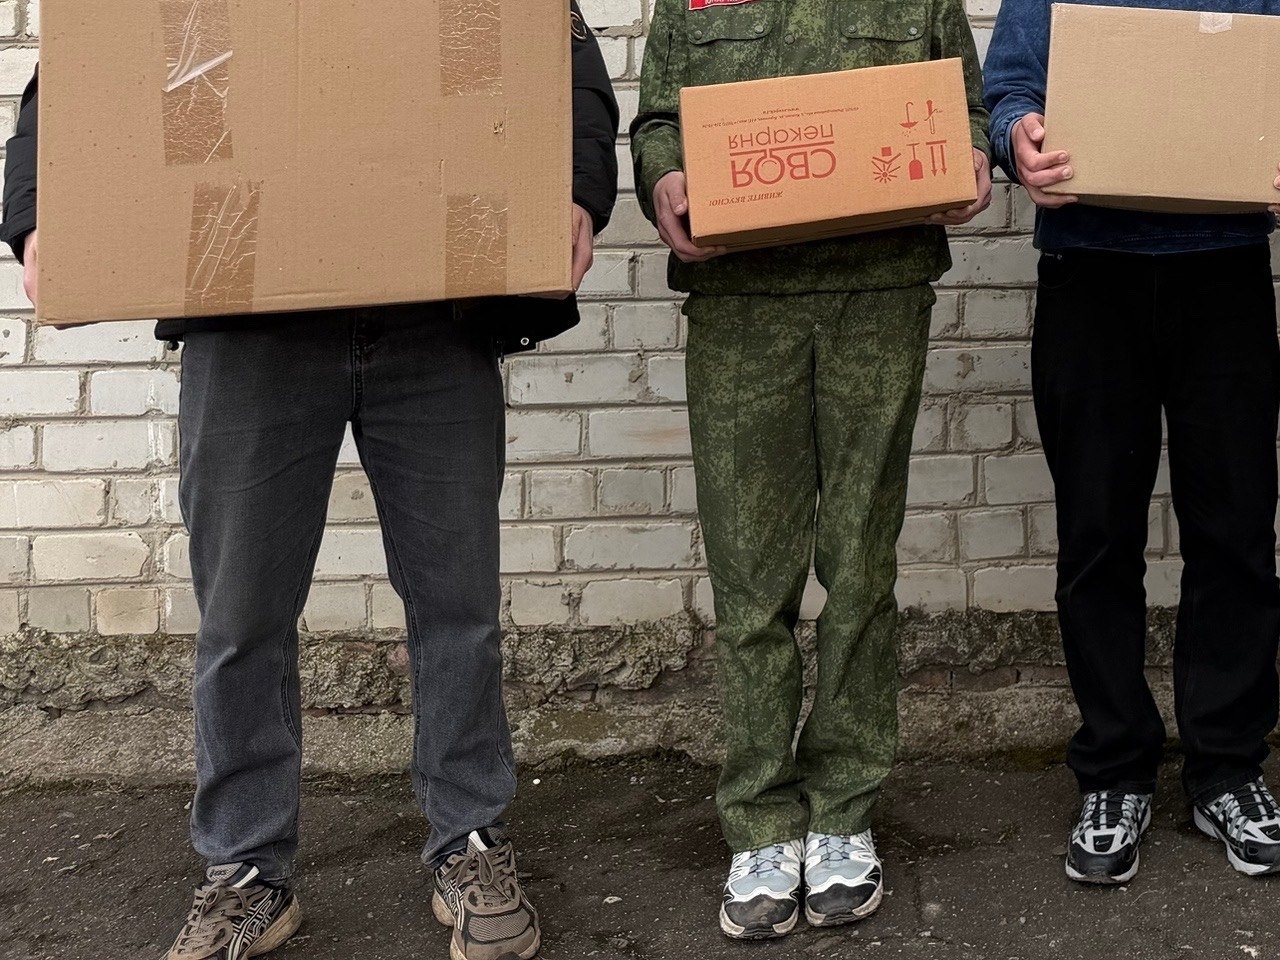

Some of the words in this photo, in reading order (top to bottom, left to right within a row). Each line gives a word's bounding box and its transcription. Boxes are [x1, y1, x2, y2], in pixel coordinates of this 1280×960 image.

[728, 123, 835, 149] пекарня
[730, 148, 837, 189] СВОЯ
[708, 194, 747, 206] ВКУСНО!
[748, 190, 784, 202] ЖИВИТЕ
